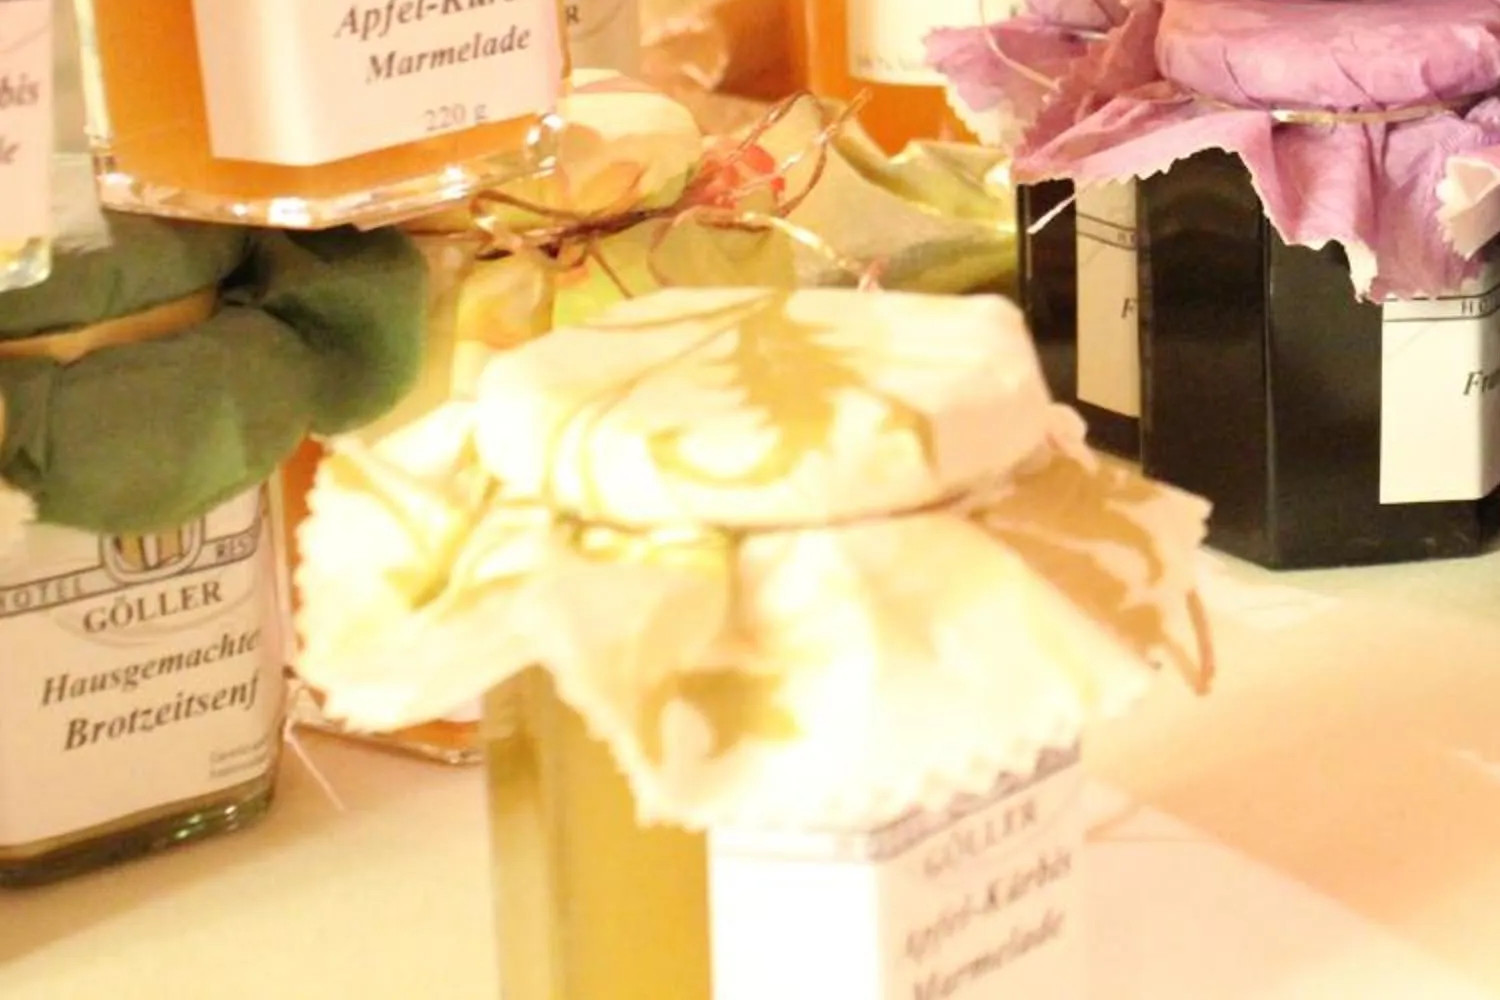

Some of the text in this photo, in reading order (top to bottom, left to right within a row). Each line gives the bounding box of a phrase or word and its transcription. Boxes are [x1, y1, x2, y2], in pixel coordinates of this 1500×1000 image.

[365, 24, 531, 87] Marmelade
[424, 102, 467, 133] 220
[83, 579, 223, 634] GÖLLER
[40, 626, 261, 708] Hausgemachte
[63, 668, 260, 751] Brotzeitsenf
